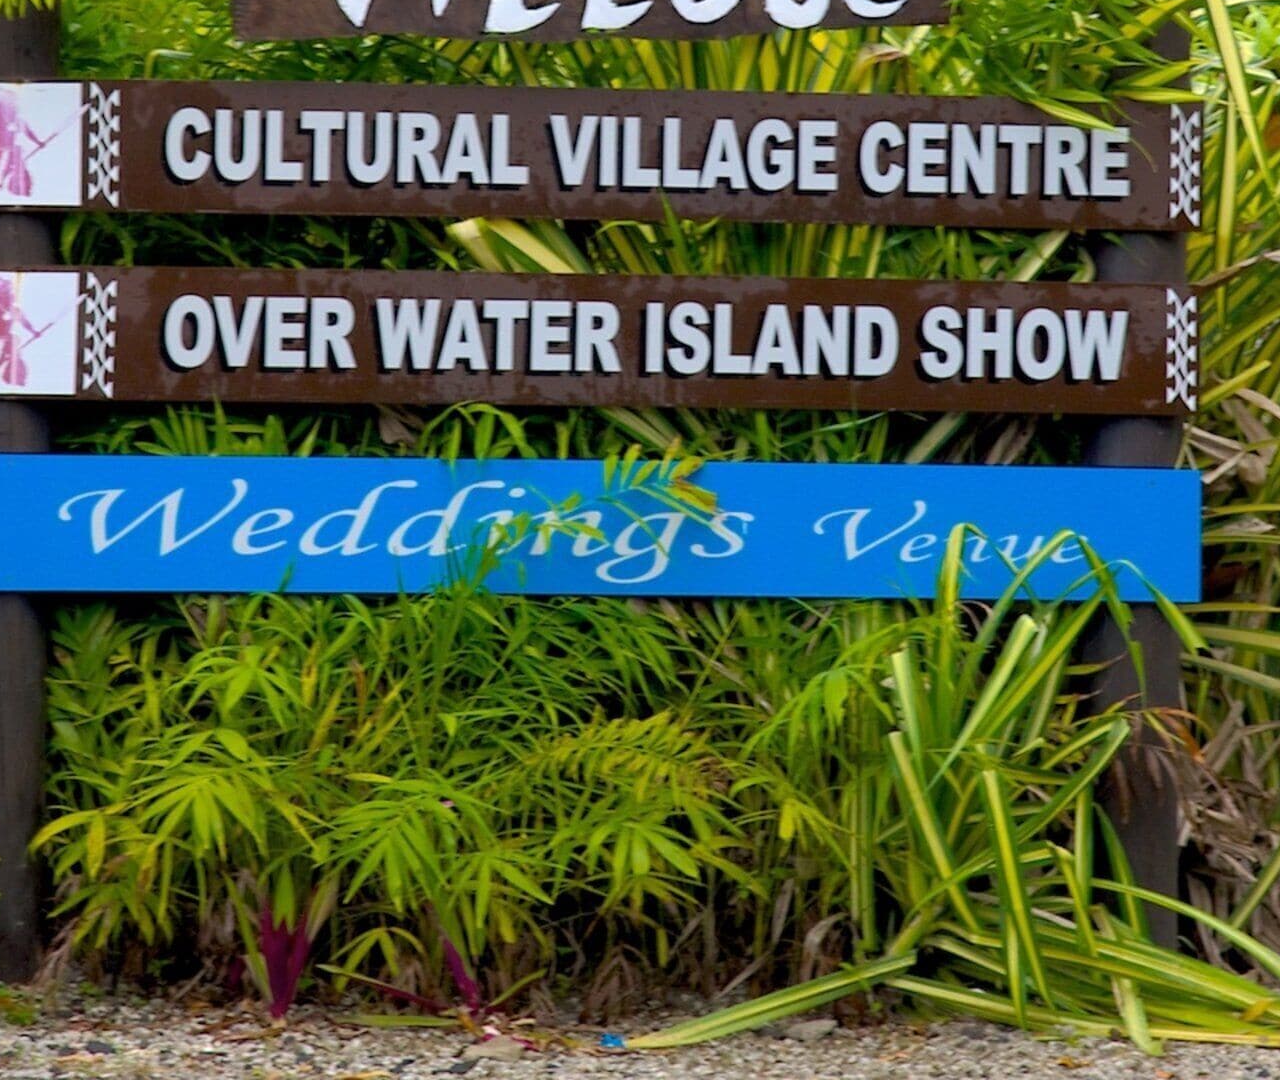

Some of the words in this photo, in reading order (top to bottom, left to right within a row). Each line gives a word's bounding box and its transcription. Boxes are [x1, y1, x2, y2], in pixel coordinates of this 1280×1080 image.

[163, 106, 530, 186] CULTURAL
[548, 113, 840, 193] VILLAGE
[859, 120, 1132, 197] CENTRE
[163, 294, 357, 371] OVER
[375, 297, 622, 374] WATER
[644, 301, 899, 378] ISLAND
[919, 306, 1129, 382] SHOW
[57, 477, 756, 586] Weddings
